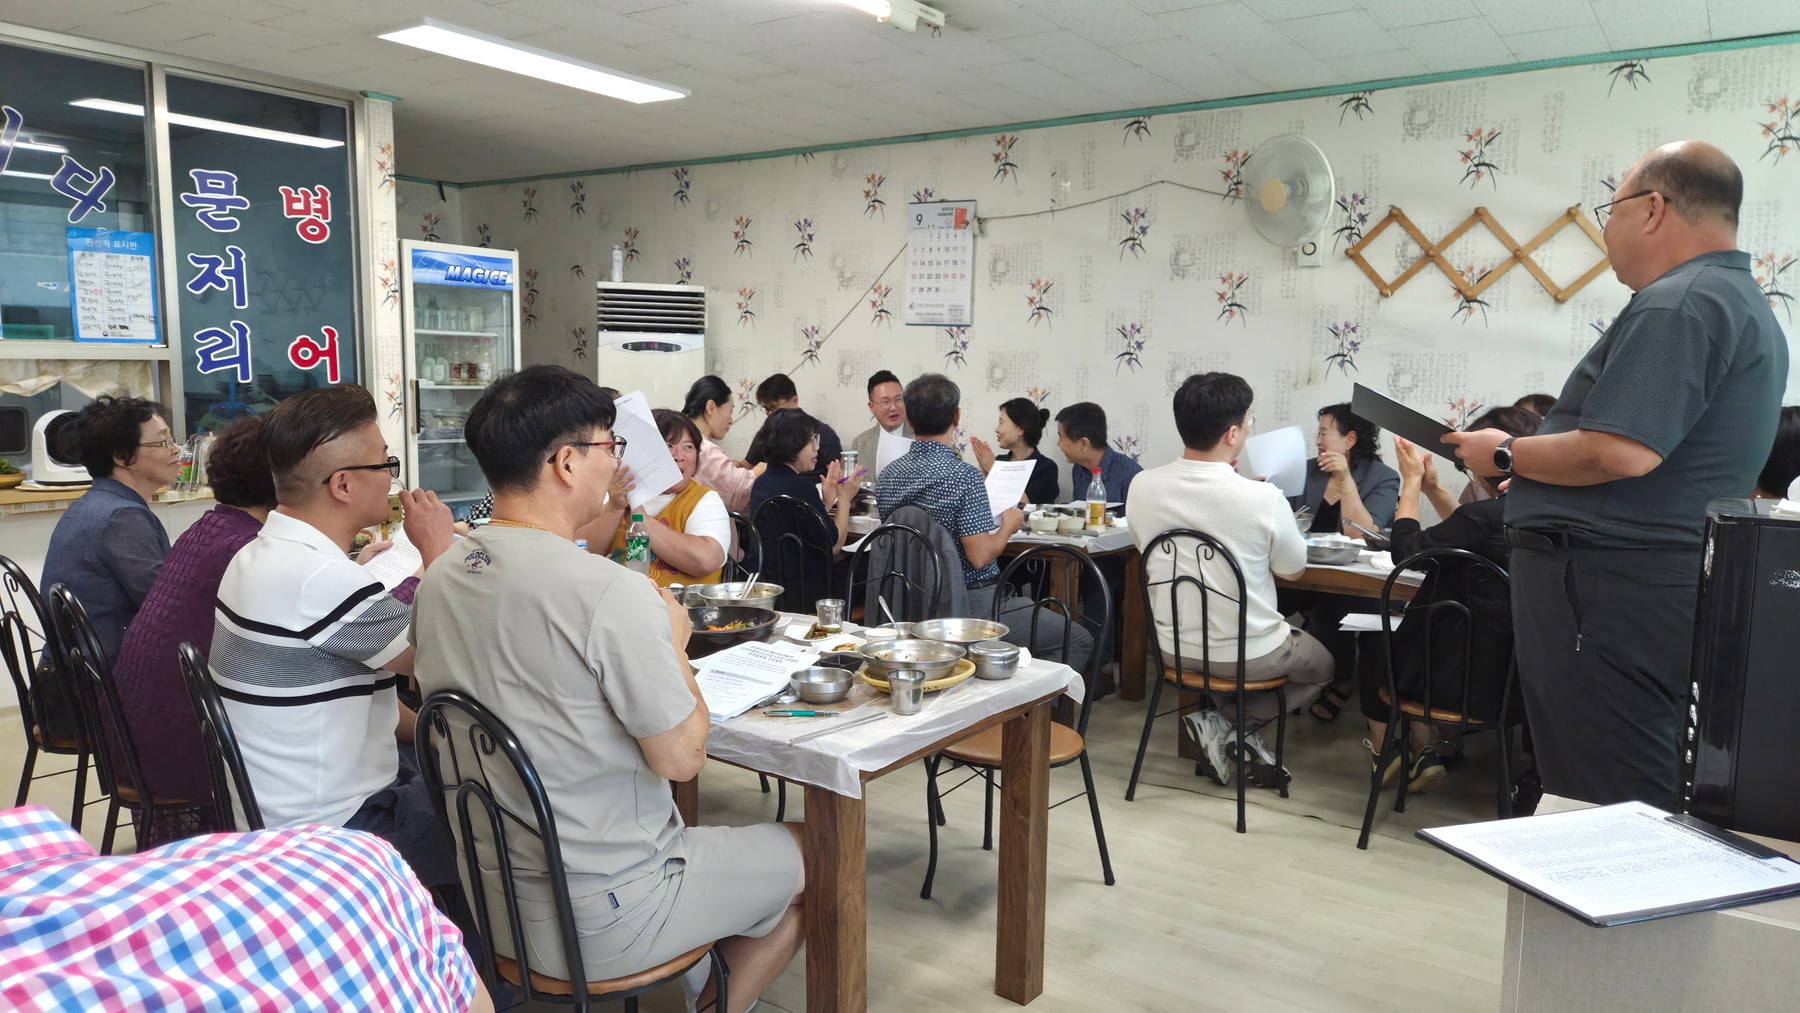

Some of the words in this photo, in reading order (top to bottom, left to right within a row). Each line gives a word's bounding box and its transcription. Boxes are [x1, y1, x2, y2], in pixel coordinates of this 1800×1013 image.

[916, 213, 923, 225] 9
[180, 168, 251, 383] 문저리
[278, 184, 341, 384] 병어
[444, 264, 509, 286] MAGICE
